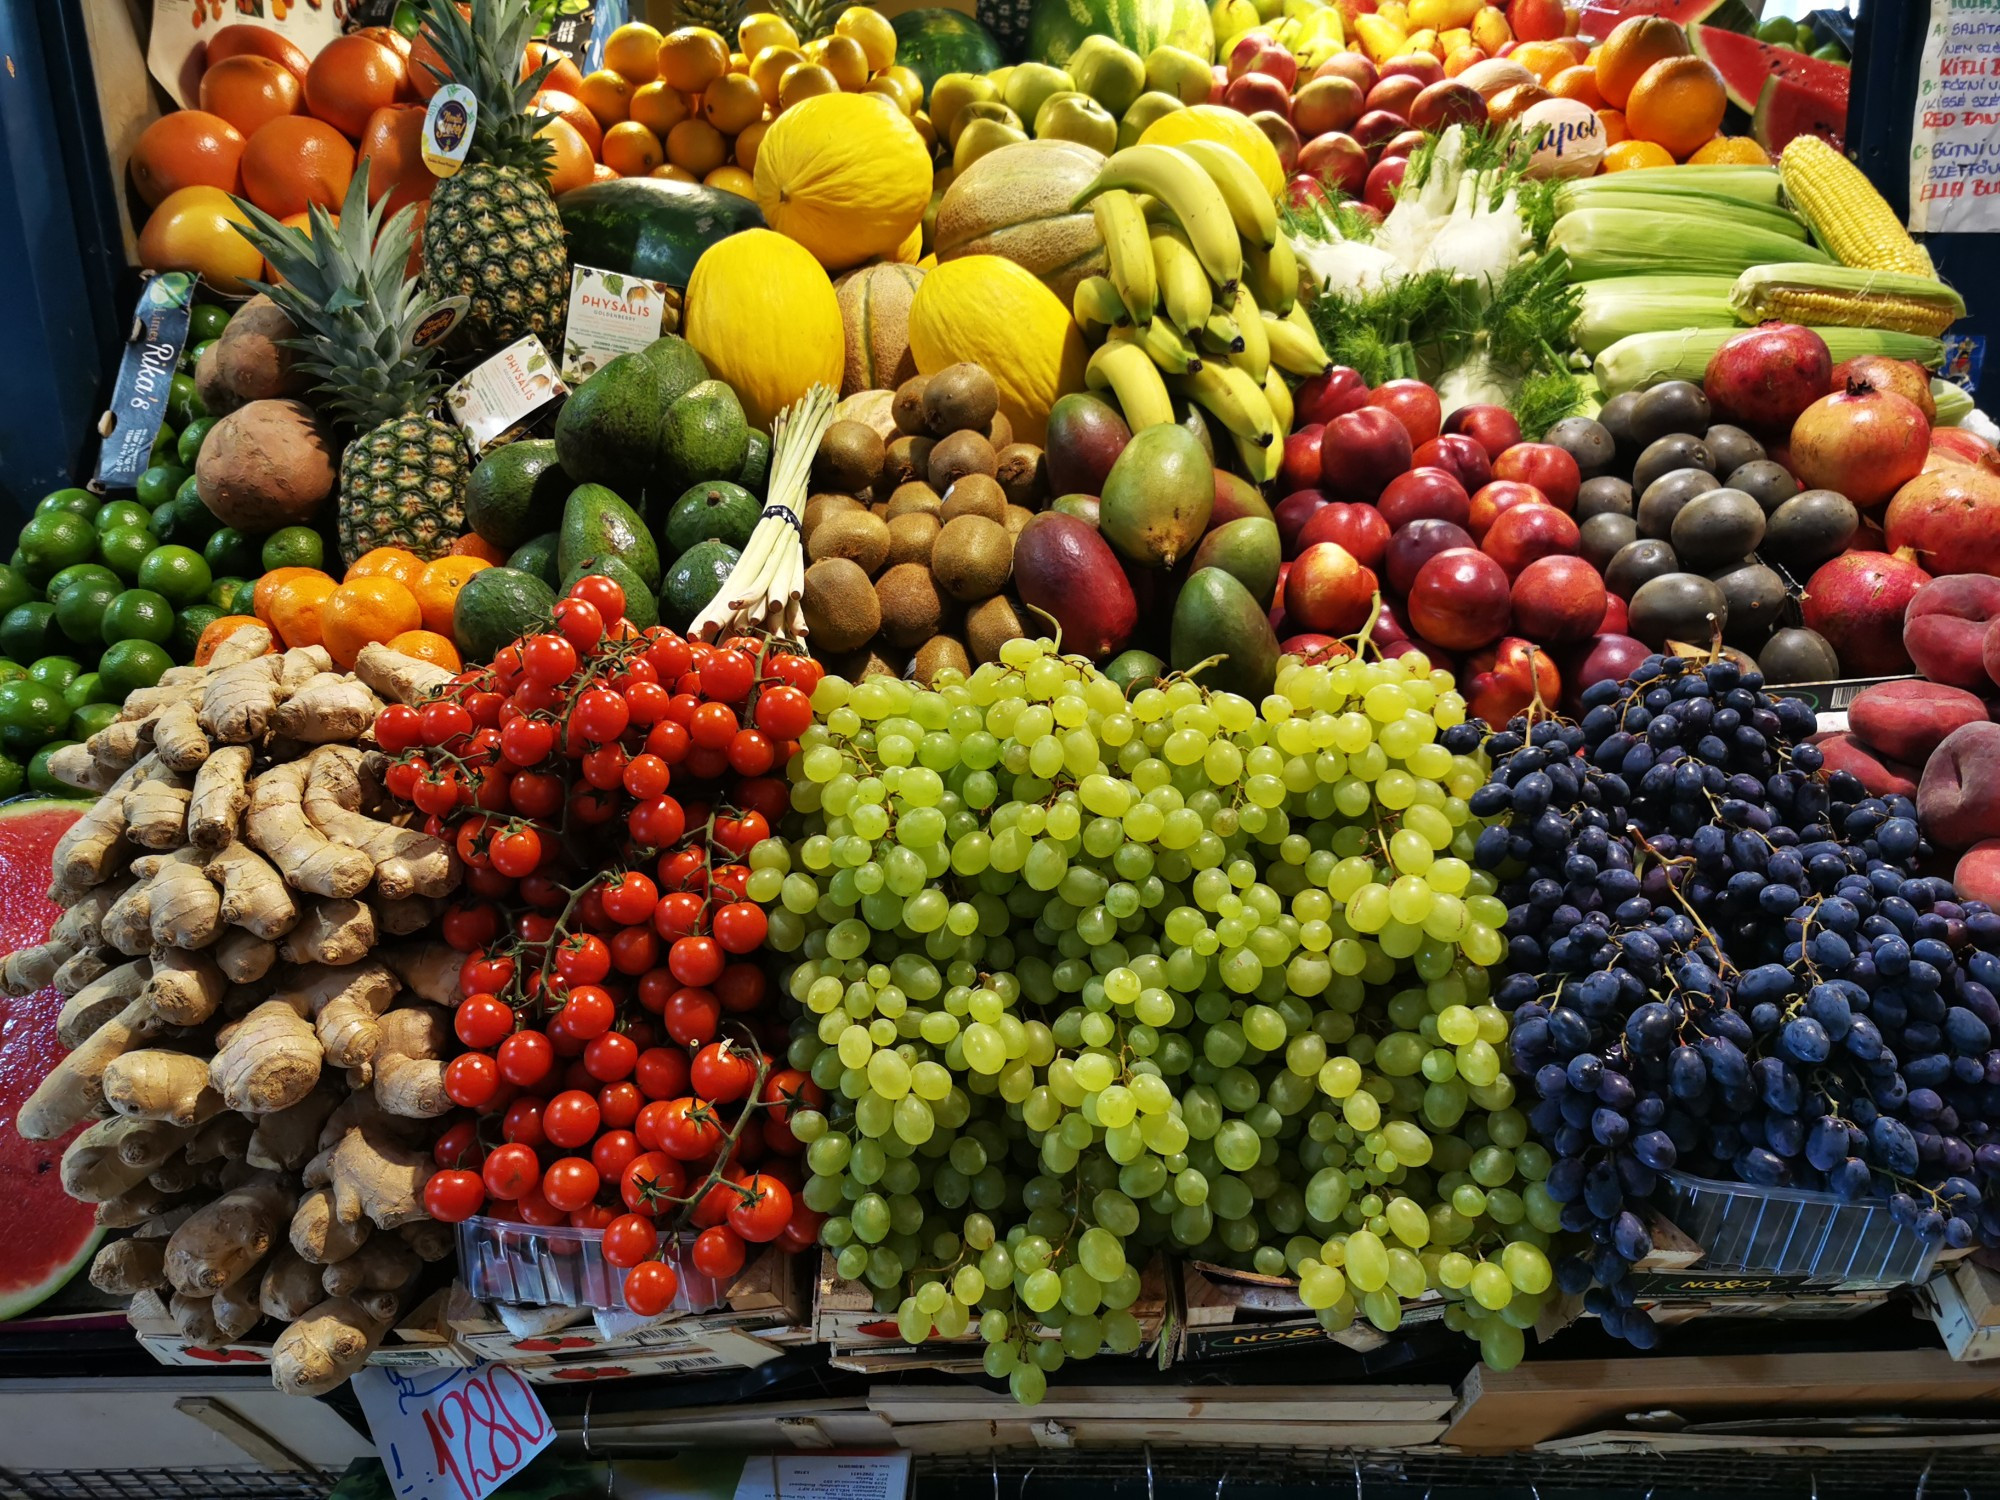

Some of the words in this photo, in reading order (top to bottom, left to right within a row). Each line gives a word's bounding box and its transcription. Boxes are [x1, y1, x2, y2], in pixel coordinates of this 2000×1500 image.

[1922, 111, 1956, 129] RED
[582, 295, 650, 317] PHYSALIS
[593, 309, 636, 322] GOLDENBERRY
[147, 307, 167, 342] Limes
[130, 343, 175, 410] Rika's
[504, 354, 535, 401] PHYSALIS
[1680, 1279, 1772, 1290] NO&CA
[1233, 1327, 1327, 1344] NO&
[421, 1362, 545, 1500] 1280
